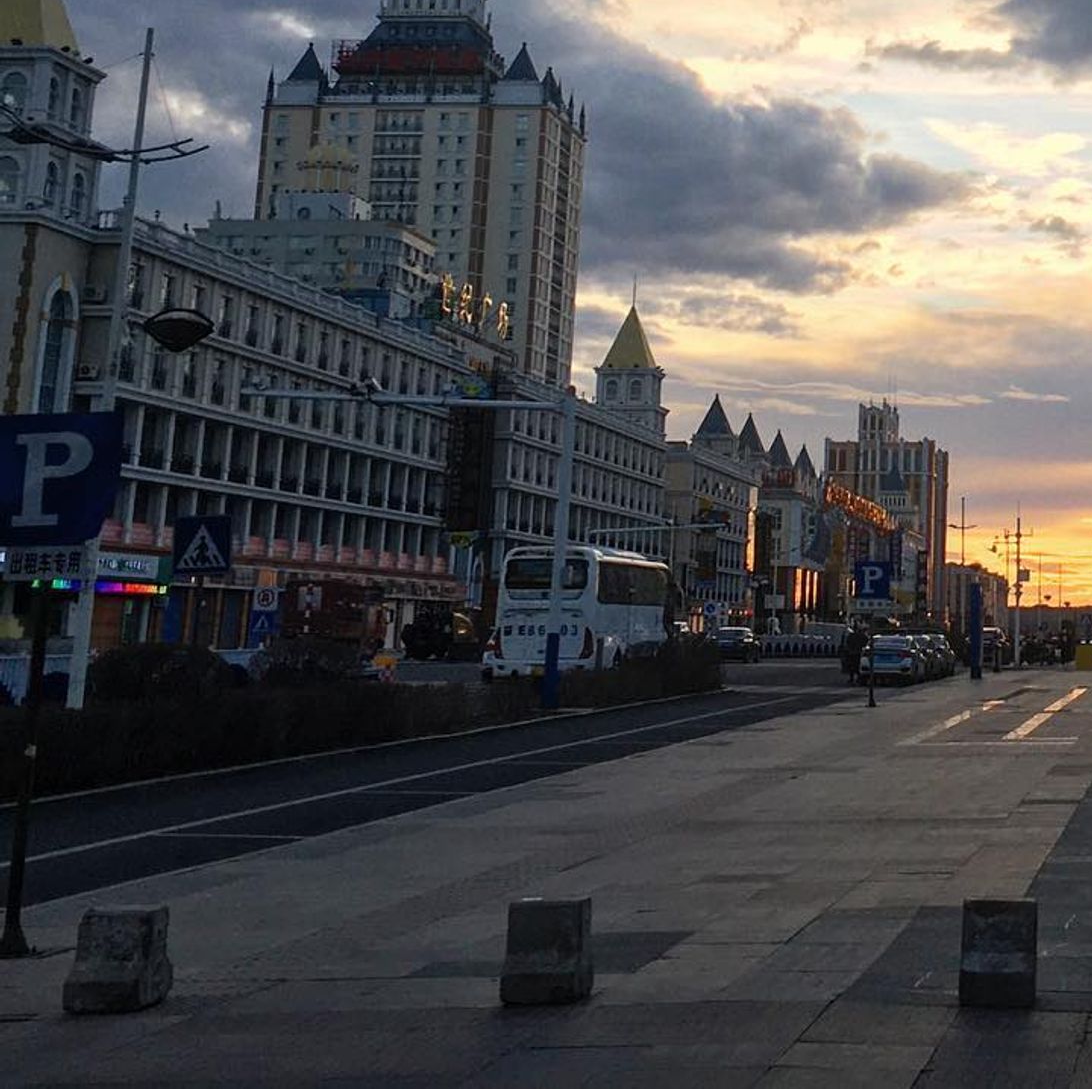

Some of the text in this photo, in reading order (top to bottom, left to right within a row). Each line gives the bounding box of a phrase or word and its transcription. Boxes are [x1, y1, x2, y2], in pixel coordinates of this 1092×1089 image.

[11, 430, 95, 528] P
[10, 551, 82, 574] 出租车专用
[861, 565, 884, 594] P
